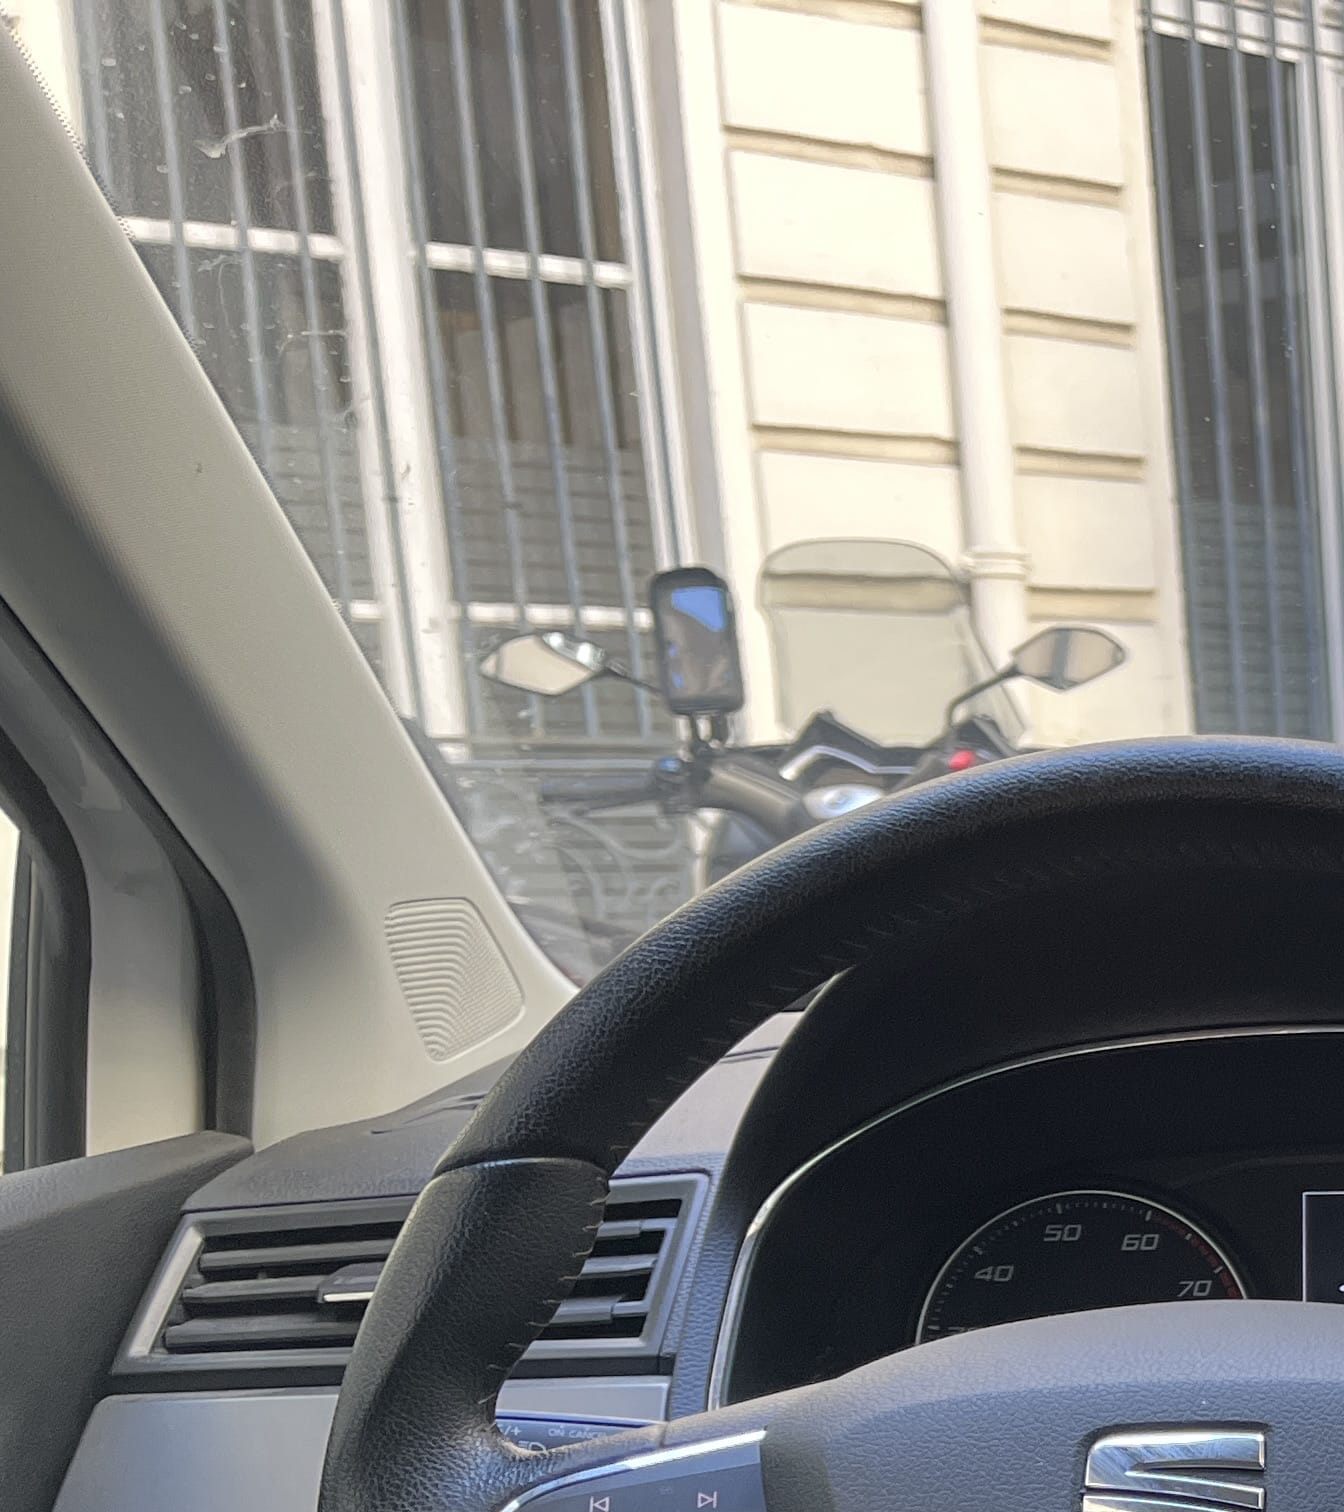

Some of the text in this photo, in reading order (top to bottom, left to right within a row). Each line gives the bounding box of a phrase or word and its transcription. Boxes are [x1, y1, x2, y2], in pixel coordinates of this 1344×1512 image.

[1043, 1224, 1082, 1242] 50
[1121, 1234, 1160, 1251] 60
[974, 1265, 1014, 1282] 40
[1176, 1280, 1213, 1297] 70
